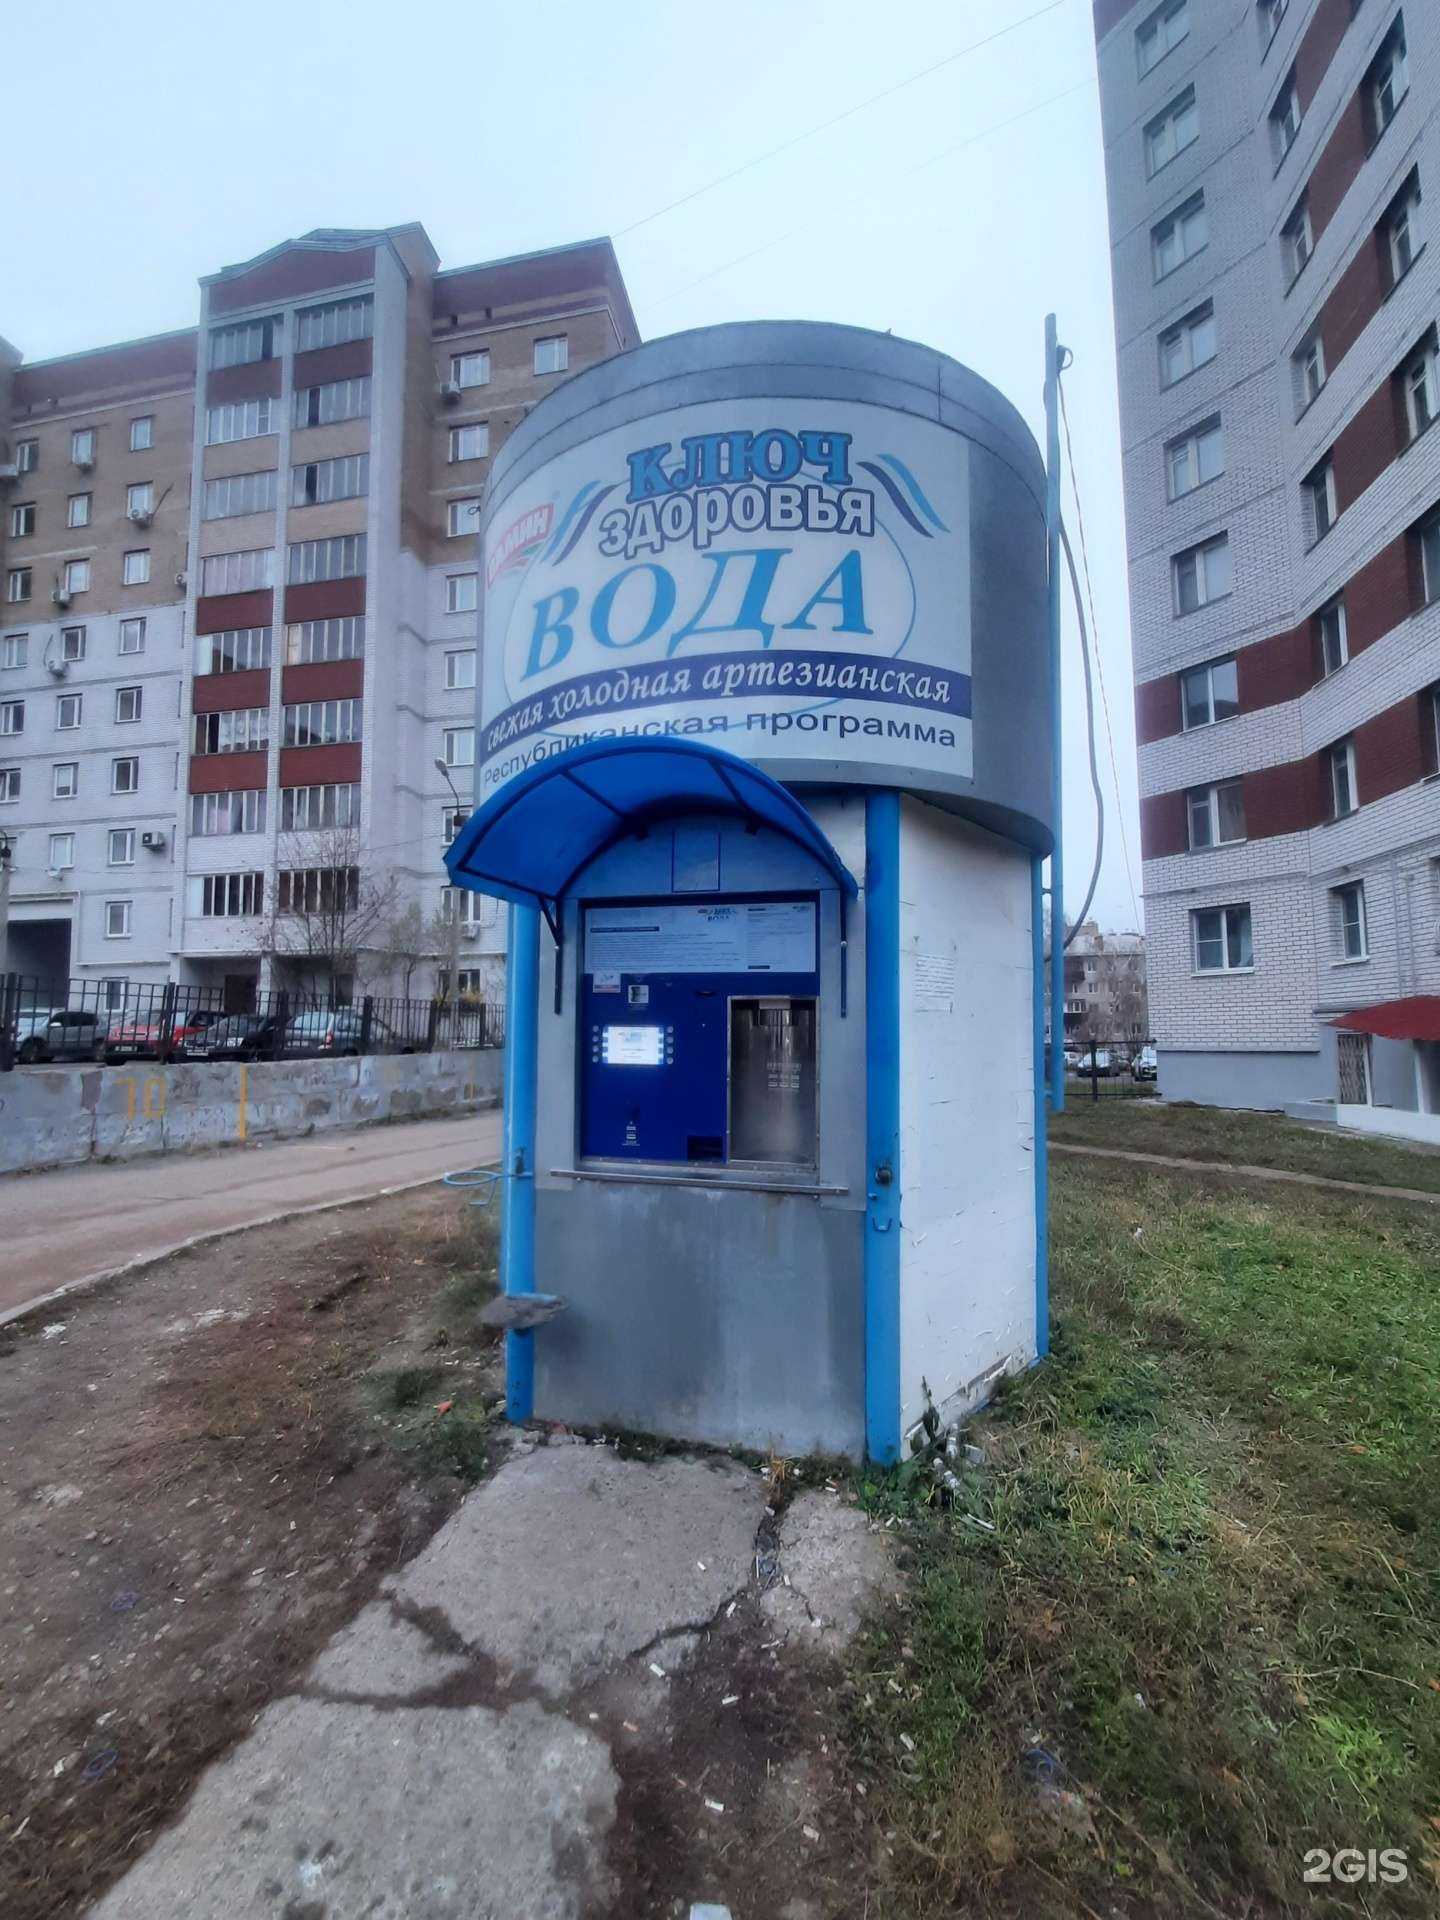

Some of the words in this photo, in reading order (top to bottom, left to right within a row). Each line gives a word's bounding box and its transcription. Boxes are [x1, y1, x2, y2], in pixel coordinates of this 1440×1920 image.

[626, 428, 853, 504] КЛЮЧ
[520, 547, 874, 682] ВОДА
[487, 701, 544, 752] свежая
[548, 668, 692, 719] холодная
[702, 661, 951, 703] артезианская
[746, 712, 956, 747] программа
